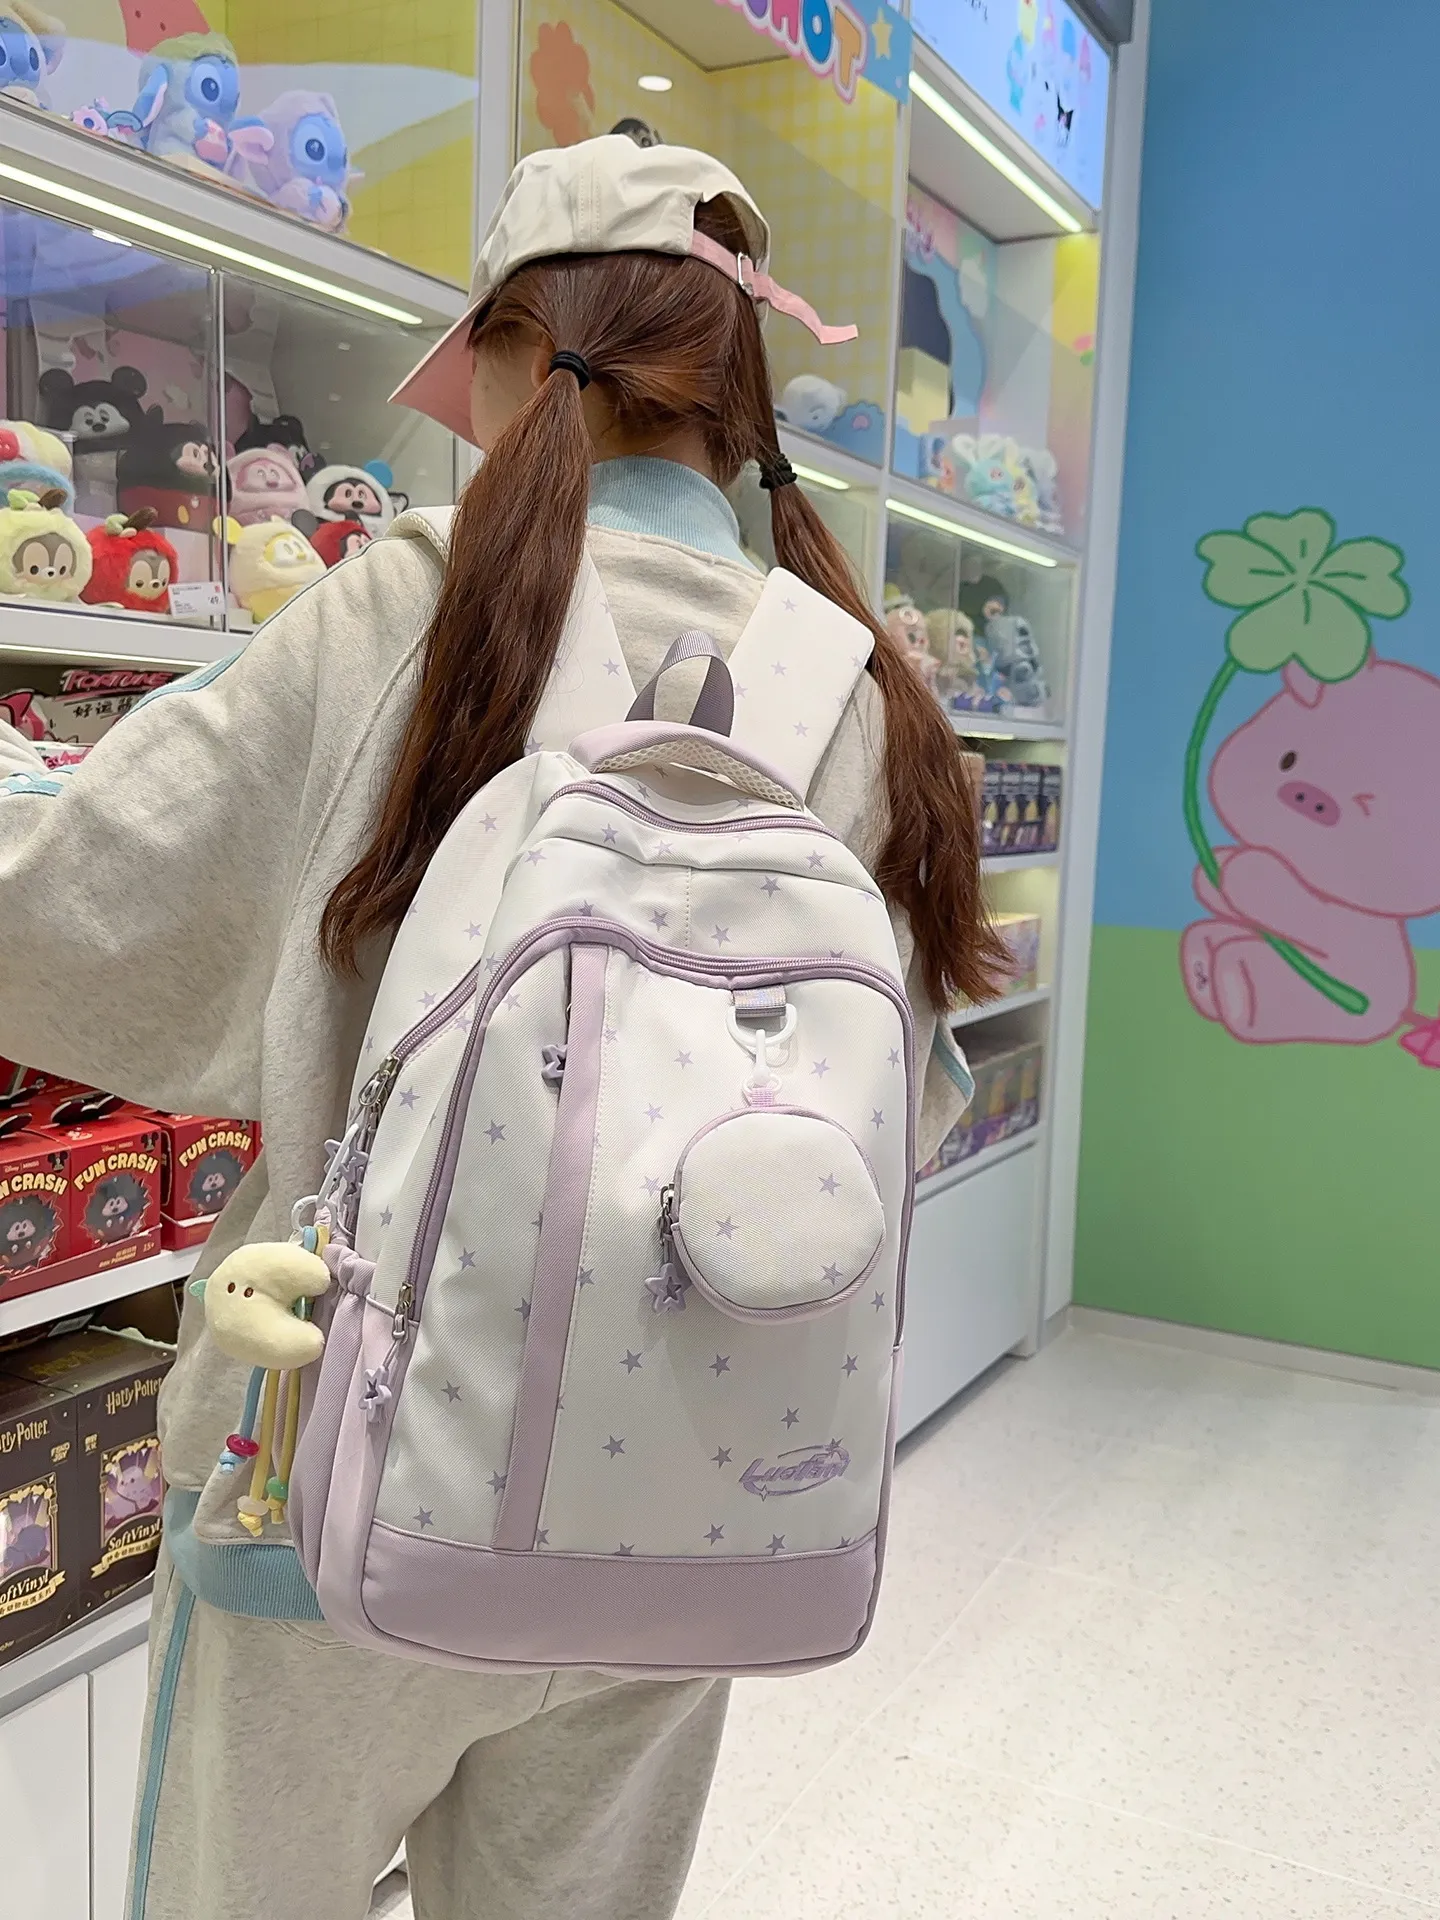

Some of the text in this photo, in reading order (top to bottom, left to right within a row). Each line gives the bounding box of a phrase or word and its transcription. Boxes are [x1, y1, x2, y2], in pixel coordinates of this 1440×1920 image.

[179, 1138, 208, 1168] FUN
[208, 1131, 252, 1151] CRASH
[11, 1172, 68, 1195] CRASH
[73, 1158, 106, 1191] FUN
[107, 1152, 159, 1174] CRASH
[105, 1387, 134, 1415] Harry
[0, 1419, 48, 1453] rry Potter
[107, 1517, 161, 1552] SoftVinyl
